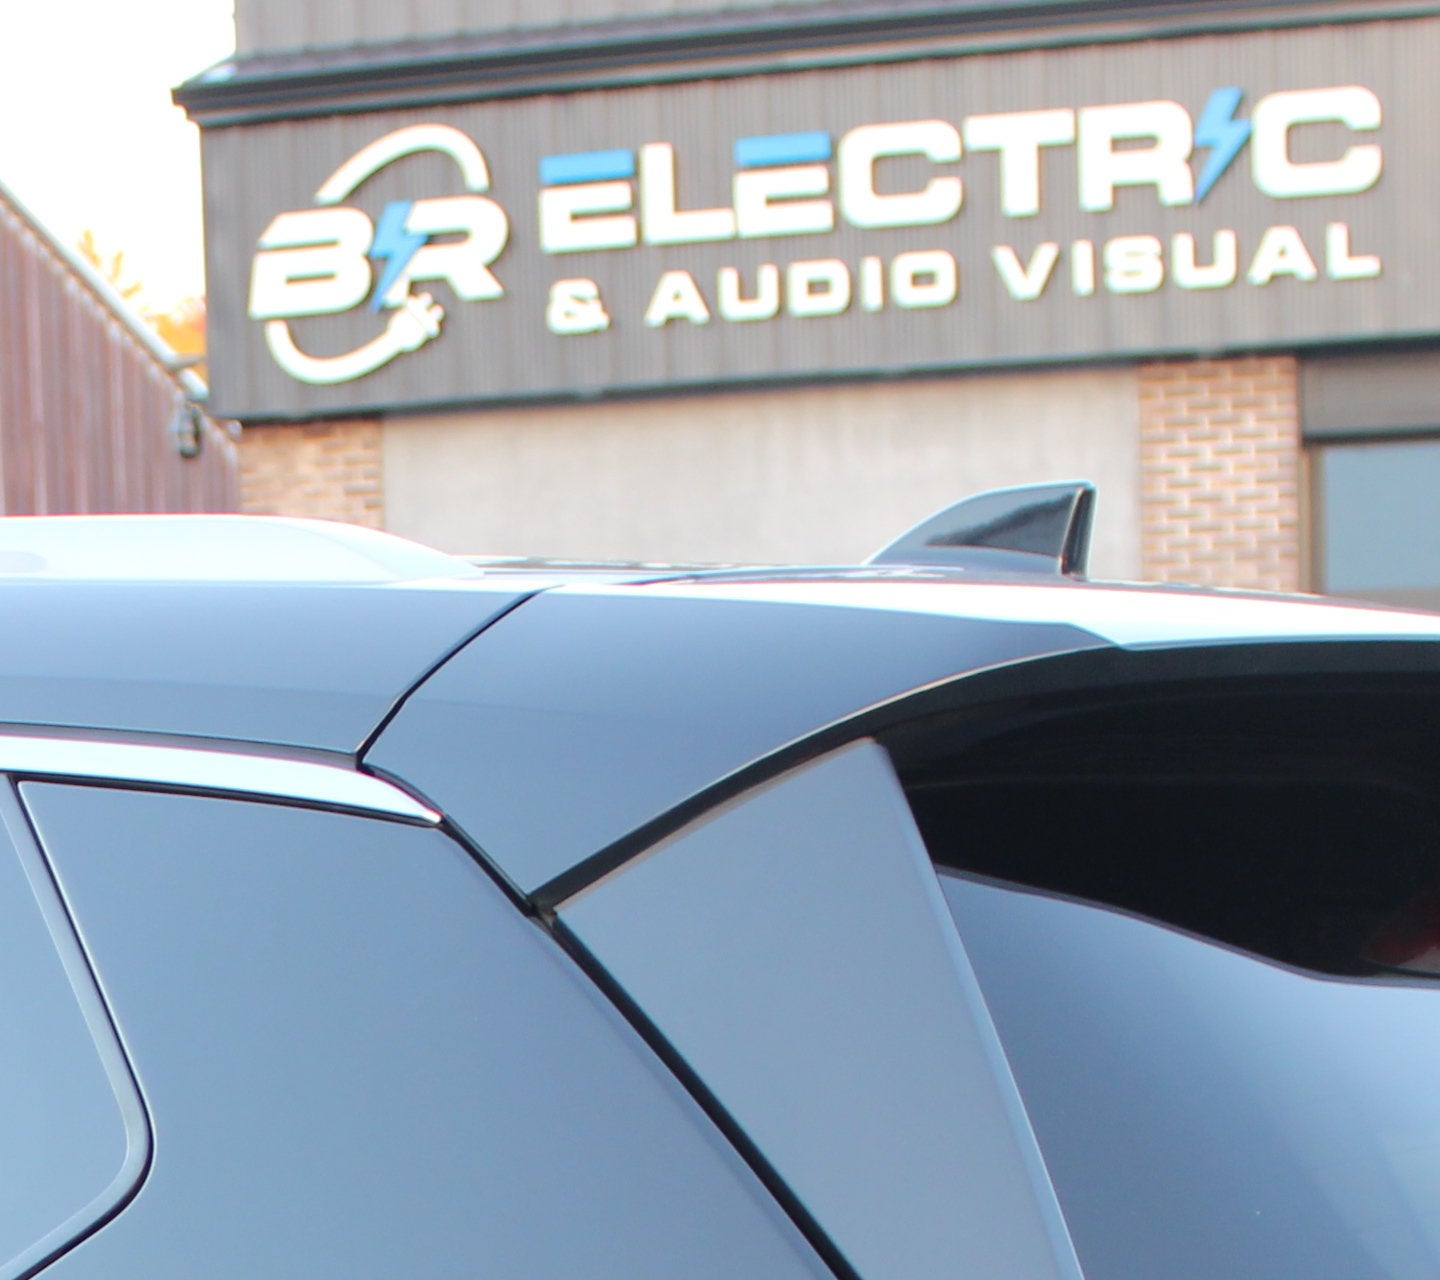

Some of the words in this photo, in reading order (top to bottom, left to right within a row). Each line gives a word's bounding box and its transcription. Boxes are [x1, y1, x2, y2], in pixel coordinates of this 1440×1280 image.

[547, 278, 609, 335] &
[645, 250, 957, 328] AUDIO
[993, 222, 1382, 301] VISUAL
